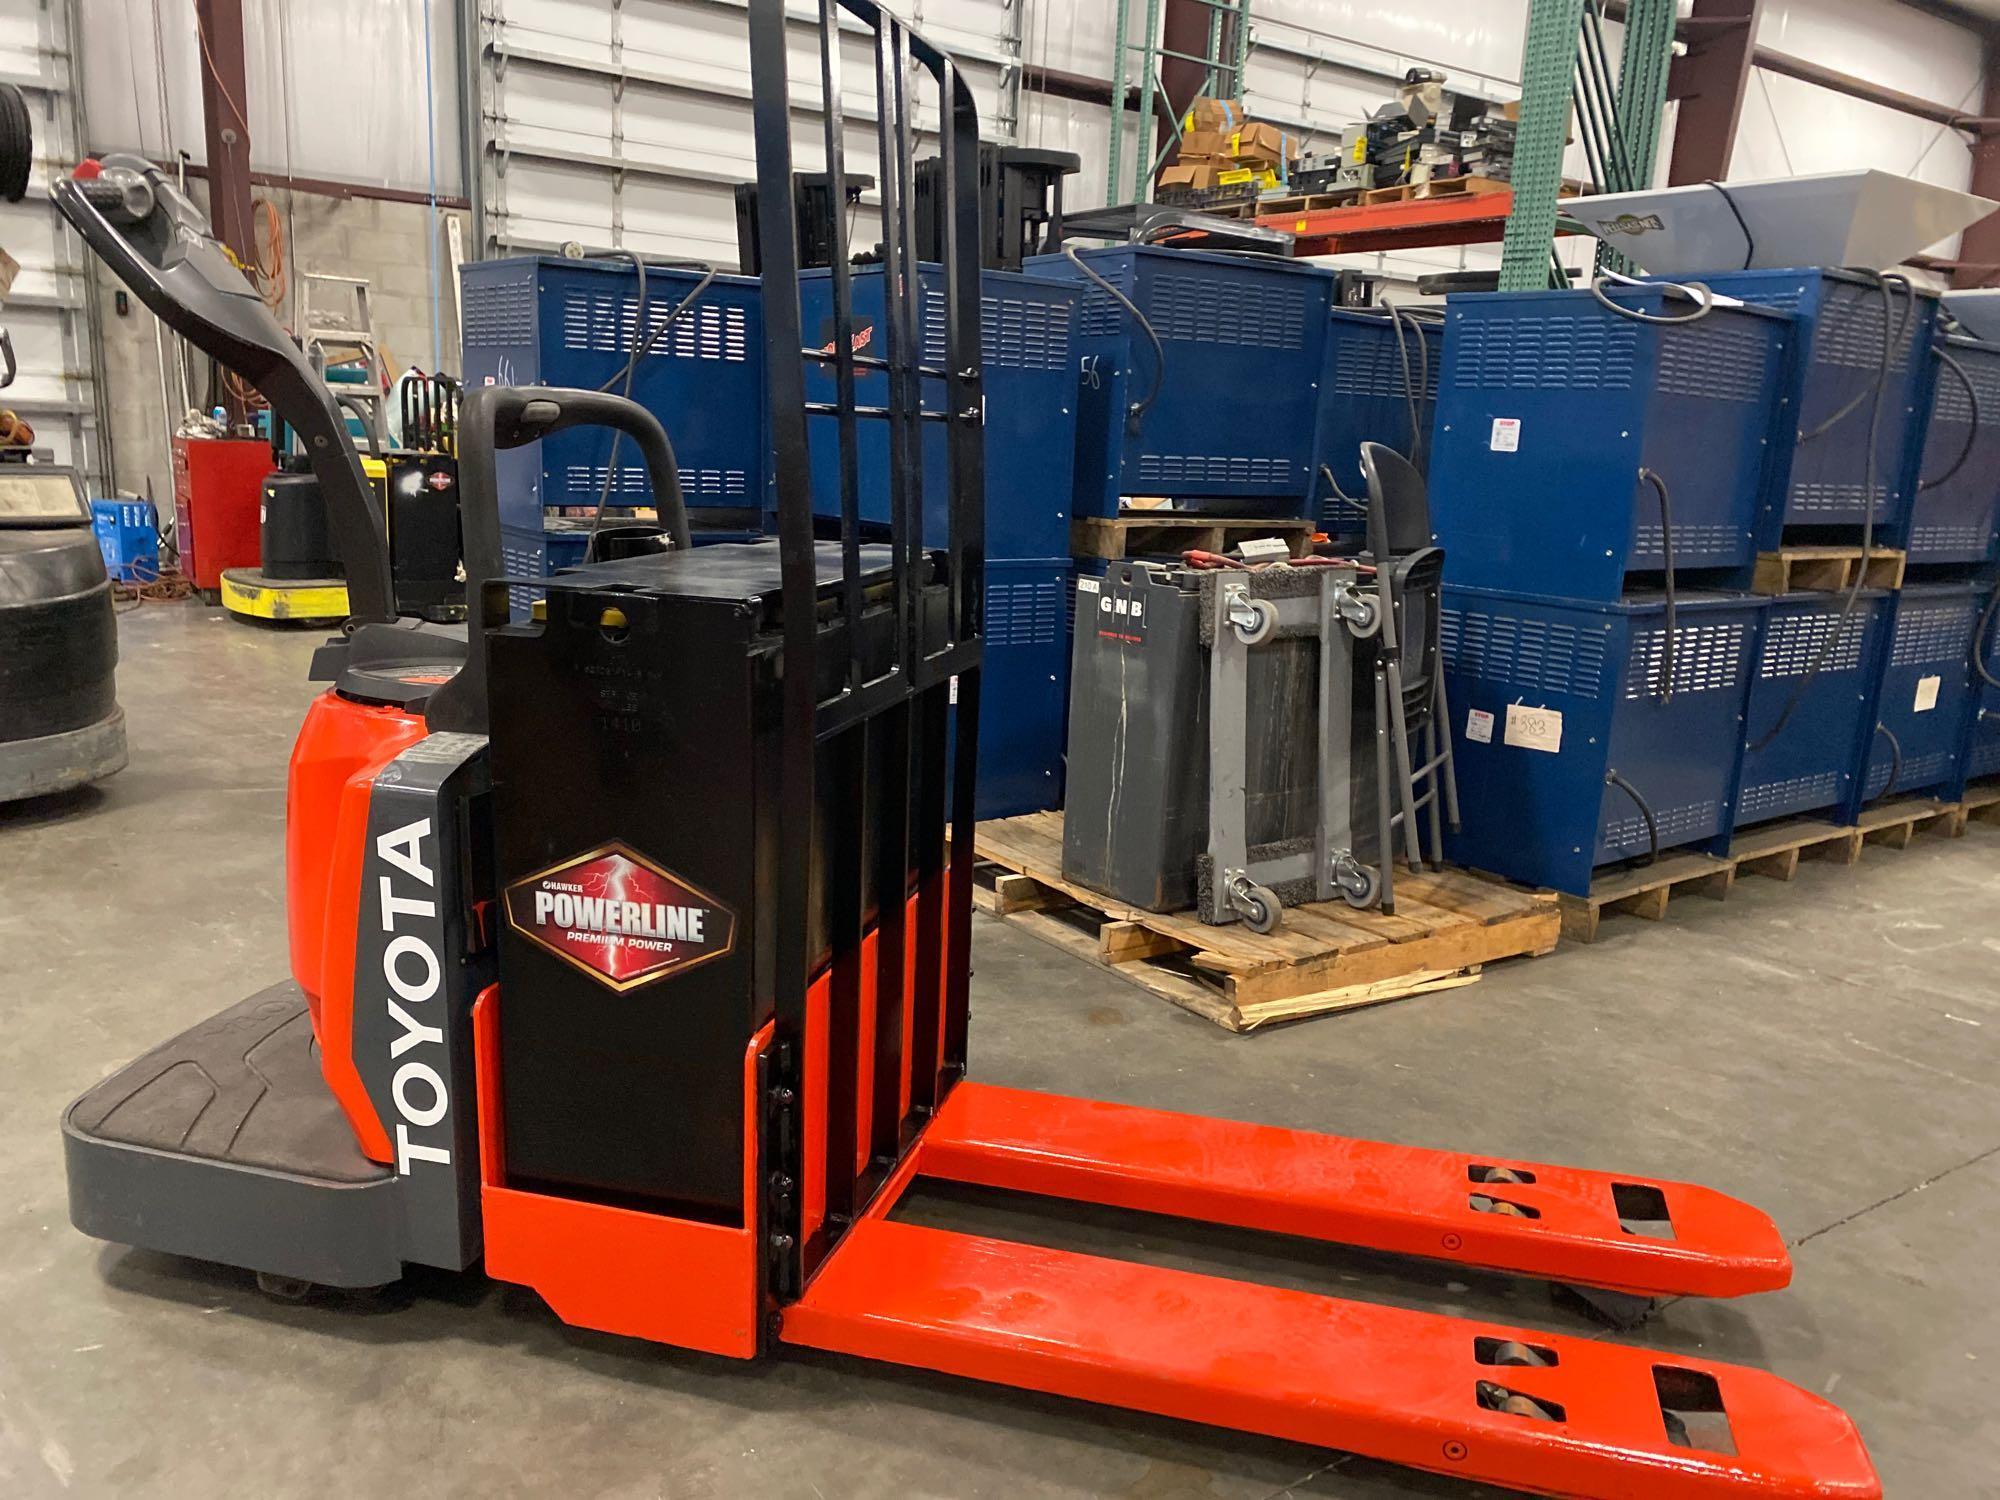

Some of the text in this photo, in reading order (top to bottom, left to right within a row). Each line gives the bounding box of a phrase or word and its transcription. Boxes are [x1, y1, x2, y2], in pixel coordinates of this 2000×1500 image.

[1100, 596, 1143, 617] GNB
[551, 881, 583, 893] HAWKER
[535, 890, 704, 943] POWERLINE
[567, 931, 673, 953] PREMIUM POWER
[376, 817, 451, 1176] TOYOTA
